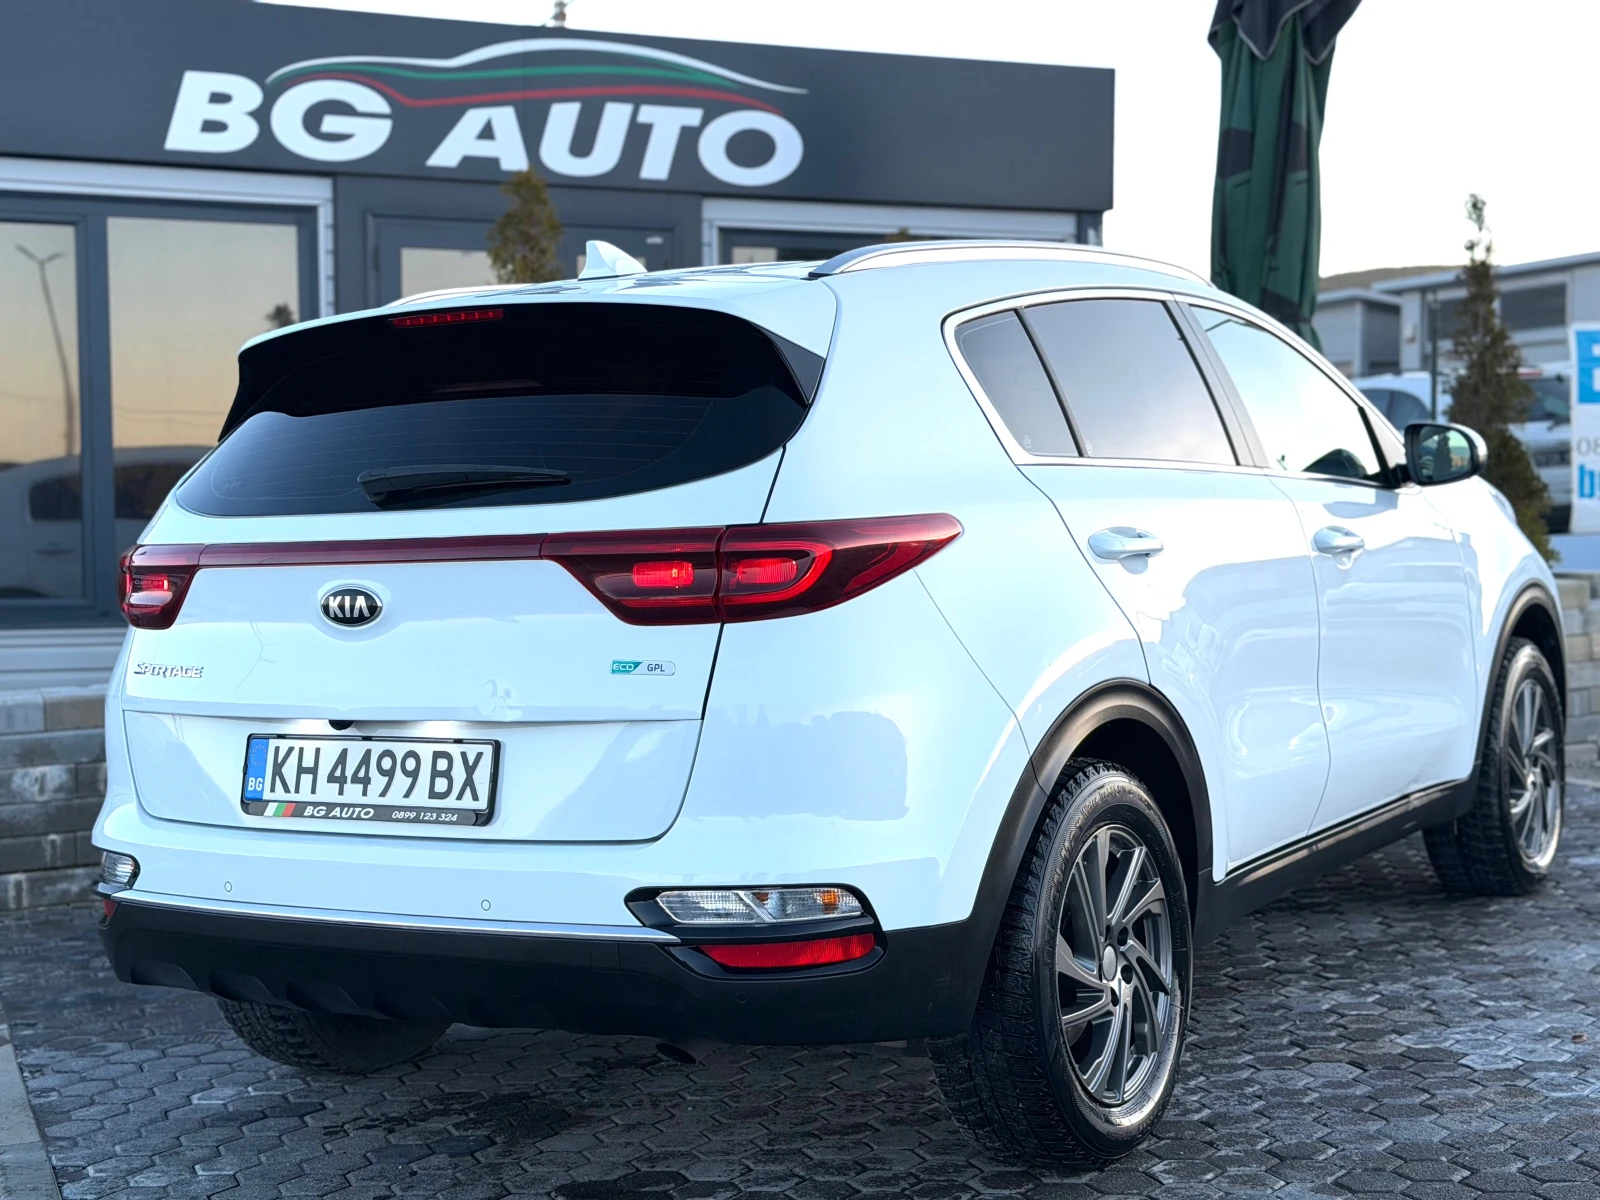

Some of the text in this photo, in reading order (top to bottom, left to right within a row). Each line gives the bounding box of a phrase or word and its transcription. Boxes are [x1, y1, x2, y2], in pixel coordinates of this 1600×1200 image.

[164, 70, 804, 187] BG AUTO
[328, 595, 371, 618] KIA
[133, 662, 204, 678] SPORTAGE
[612, 663, 665, 672] ECO GPL
[247, 777, 263, 791] BG
[303, 805, 374, 819] BG AUTO
[391, 810, 458, 822] 0899 123 324
